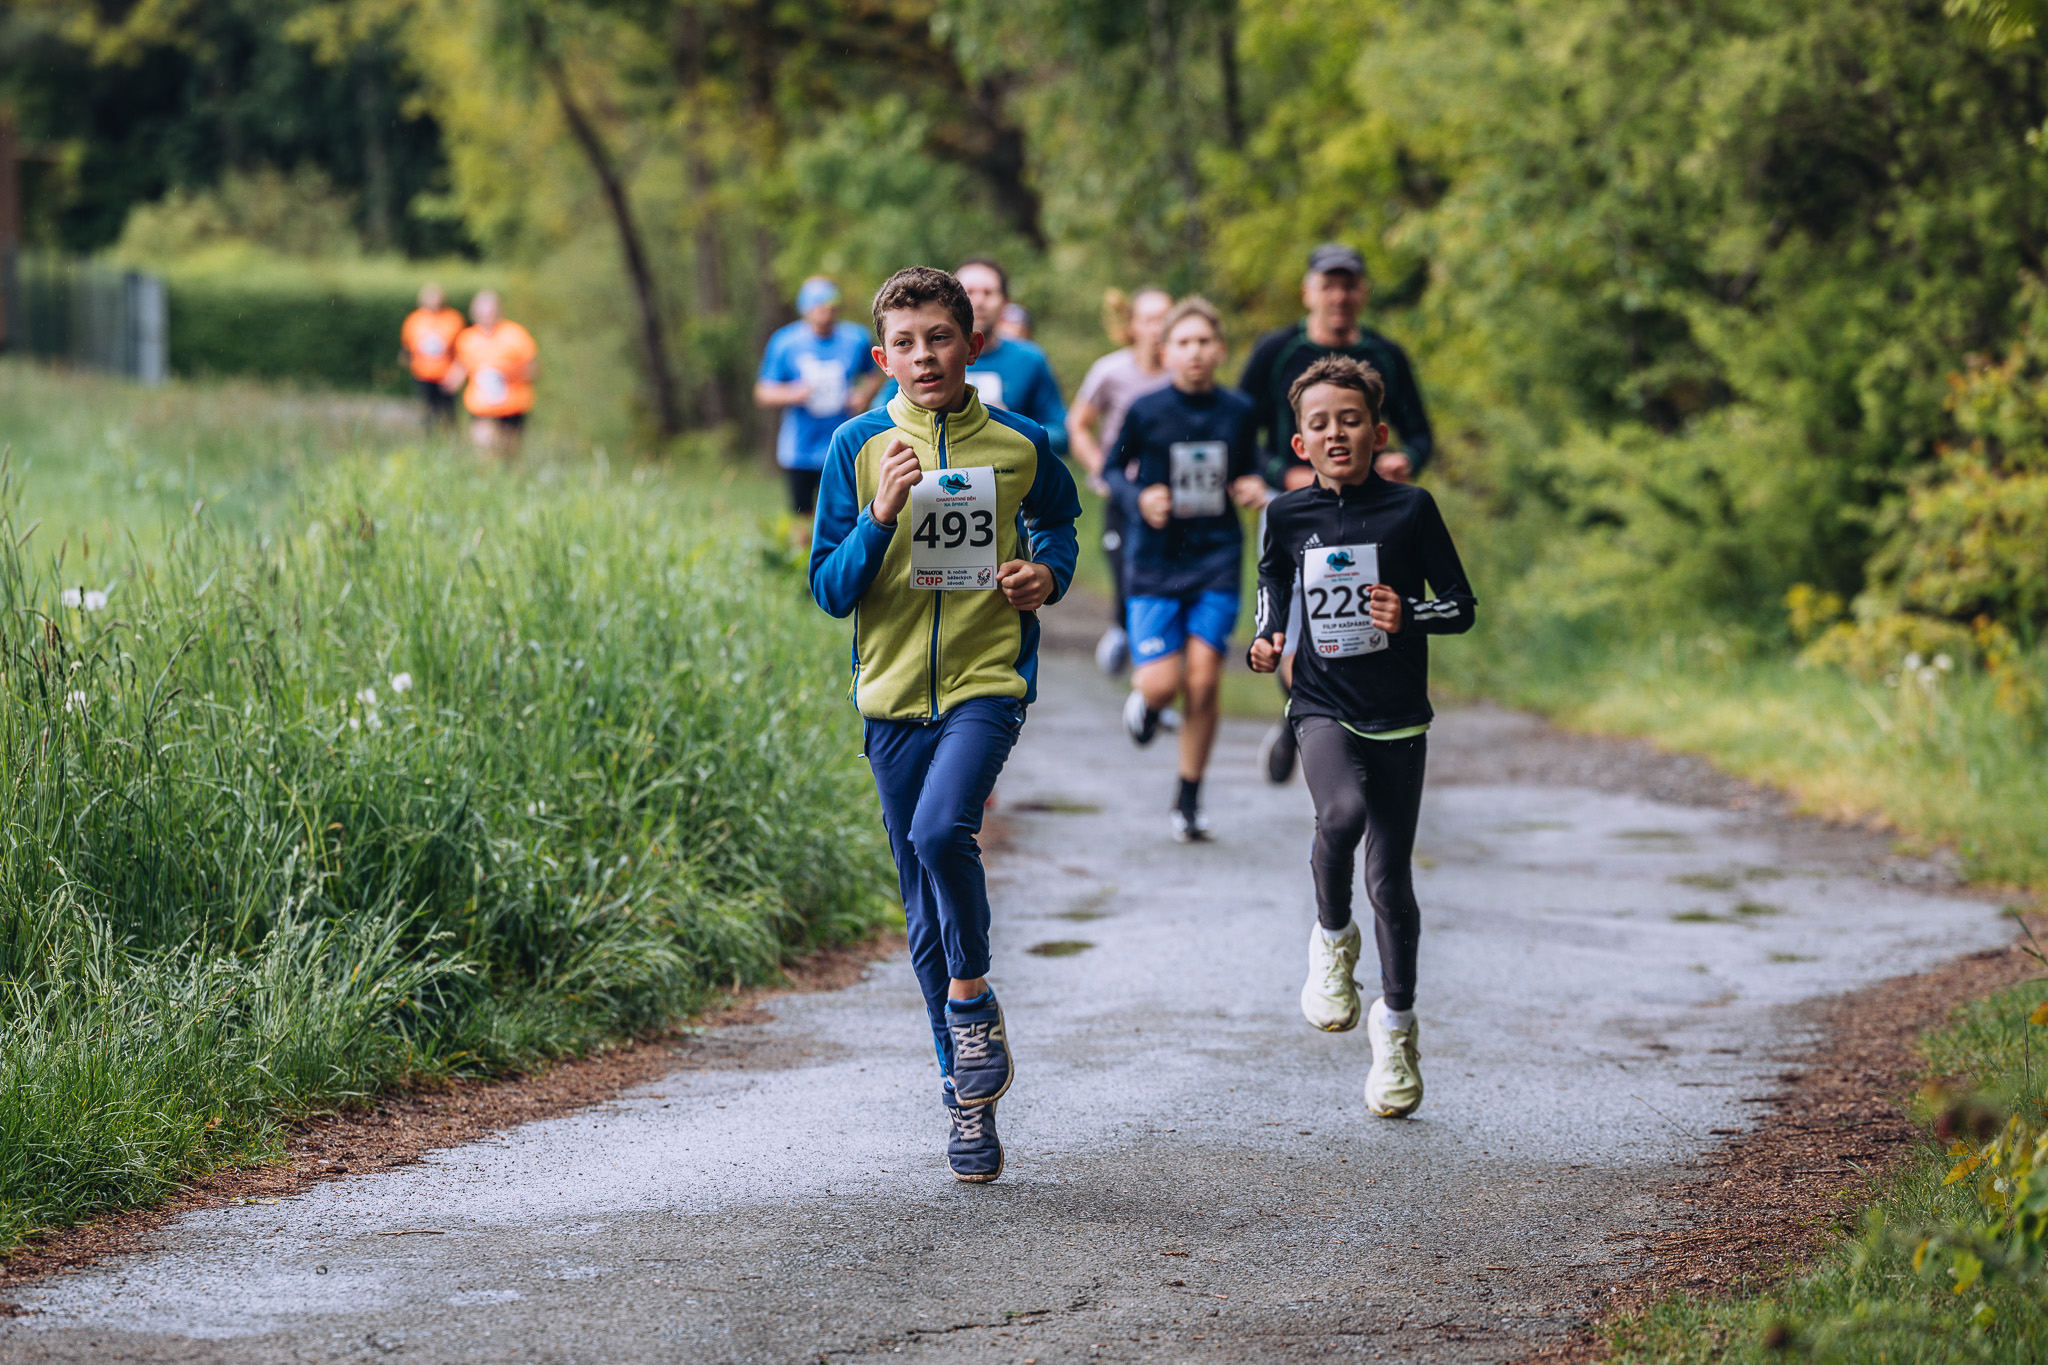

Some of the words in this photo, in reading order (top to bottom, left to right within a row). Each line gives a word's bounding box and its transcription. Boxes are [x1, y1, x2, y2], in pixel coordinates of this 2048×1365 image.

[913, 510, 993, 549] 493
[916, 577, 943, 586] CUP
[1308, 584, 1371, 620] 228
[1319, 645, 1340, 654] CUP
